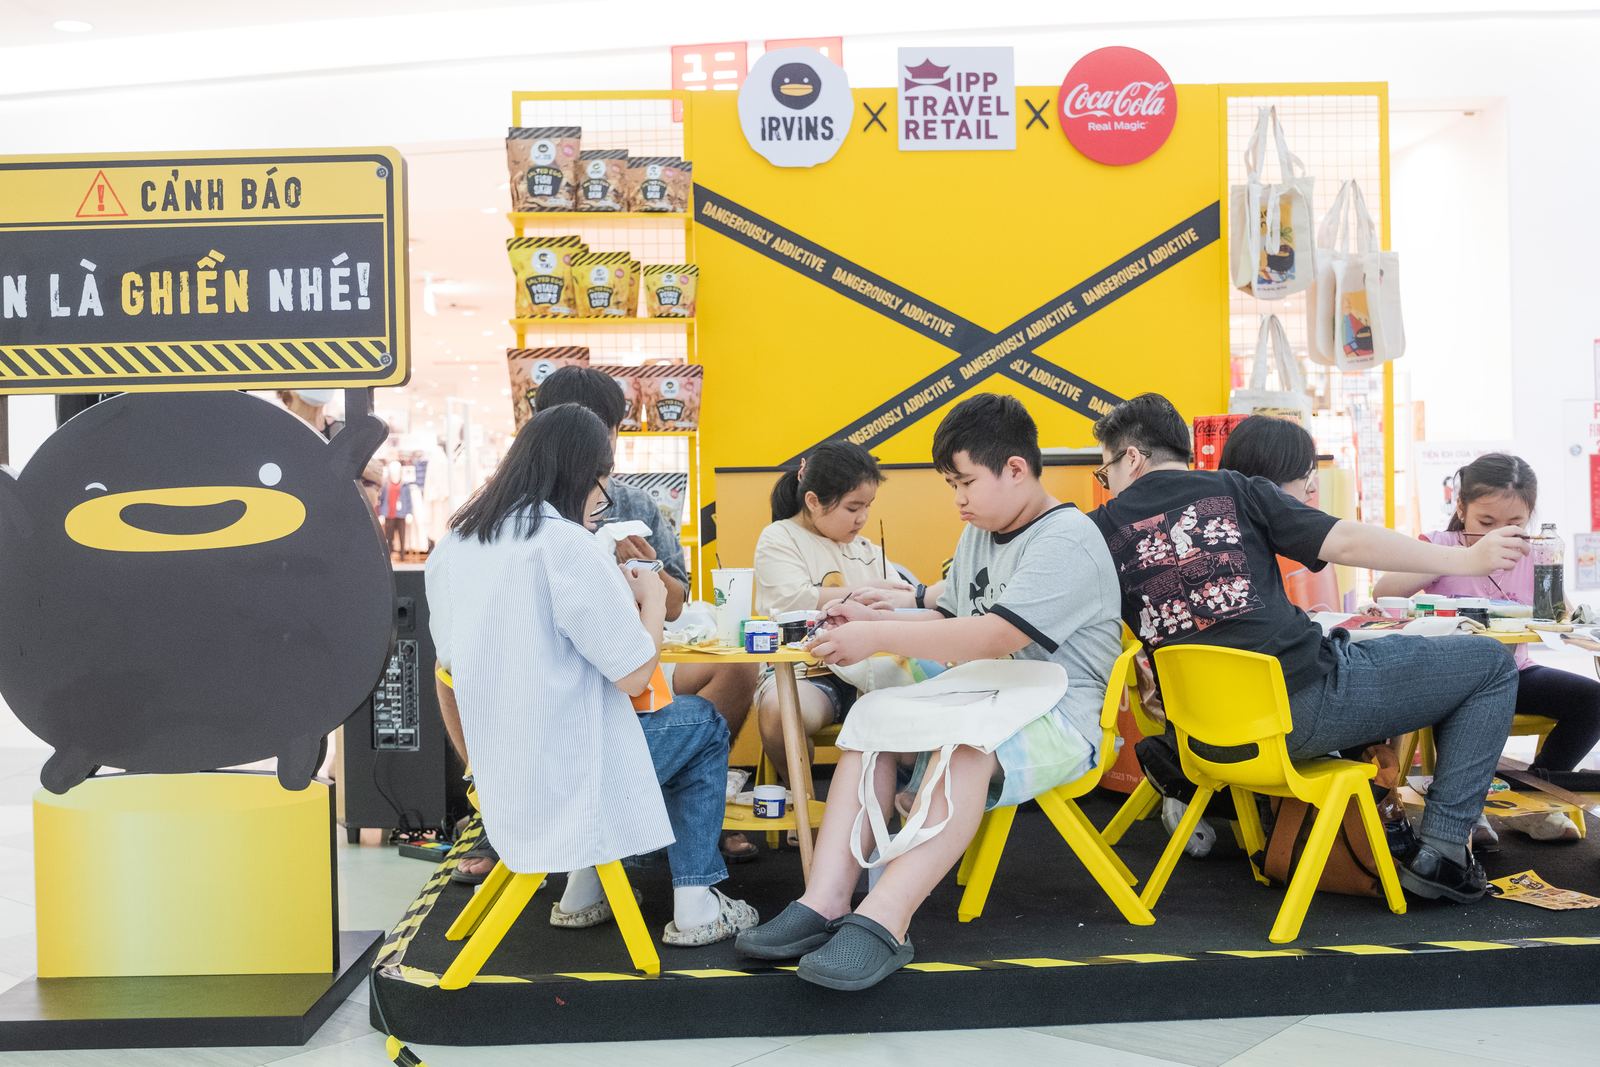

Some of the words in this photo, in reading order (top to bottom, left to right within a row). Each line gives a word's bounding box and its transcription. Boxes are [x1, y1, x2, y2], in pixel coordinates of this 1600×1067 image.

[956, 72, 998, 93] IPP
[1064, 81, 1169, 119] Coca-Cola
[905, 96, 1009, 116] TRAVEL
[760, 116, 834, 142] IRVINS
[905, 119, 998, 140] RETAIL
[1088, 121, 1112, 131] Real
[1114, 121, 1146, 132] Magic
[140, 169, 224, 212] CẢNH
[241, 166, 301, 210] BÁO
[50, 258, 104, 318] LÀ
[120, 248, 250, 317] GHIỀN
[268, 252, 372, 312] NHÉ!
[702, 201, 774, 245] DANGEROUSLY
[771, 237, 827, 273] ADDICTIVE
[831, 266, 902, 310] DANGEROUSLY
[900, 302, 955, 337] ADDICTIVE
[1081, 257, 1148, 306] DANGEROUSLY
[1148, 227, 1199, 267] ADDICTIVE
[959, 331, 1026, 380] DANGEROUSLY
[1025, 301, 1078, 340] ADDICTIVE
[1028, 366, 1083, 402] ADDICTIVE
[847, 406, 904, 446] NGEROUSLY
[903, 376, 955, 415] ADDICTIVE
